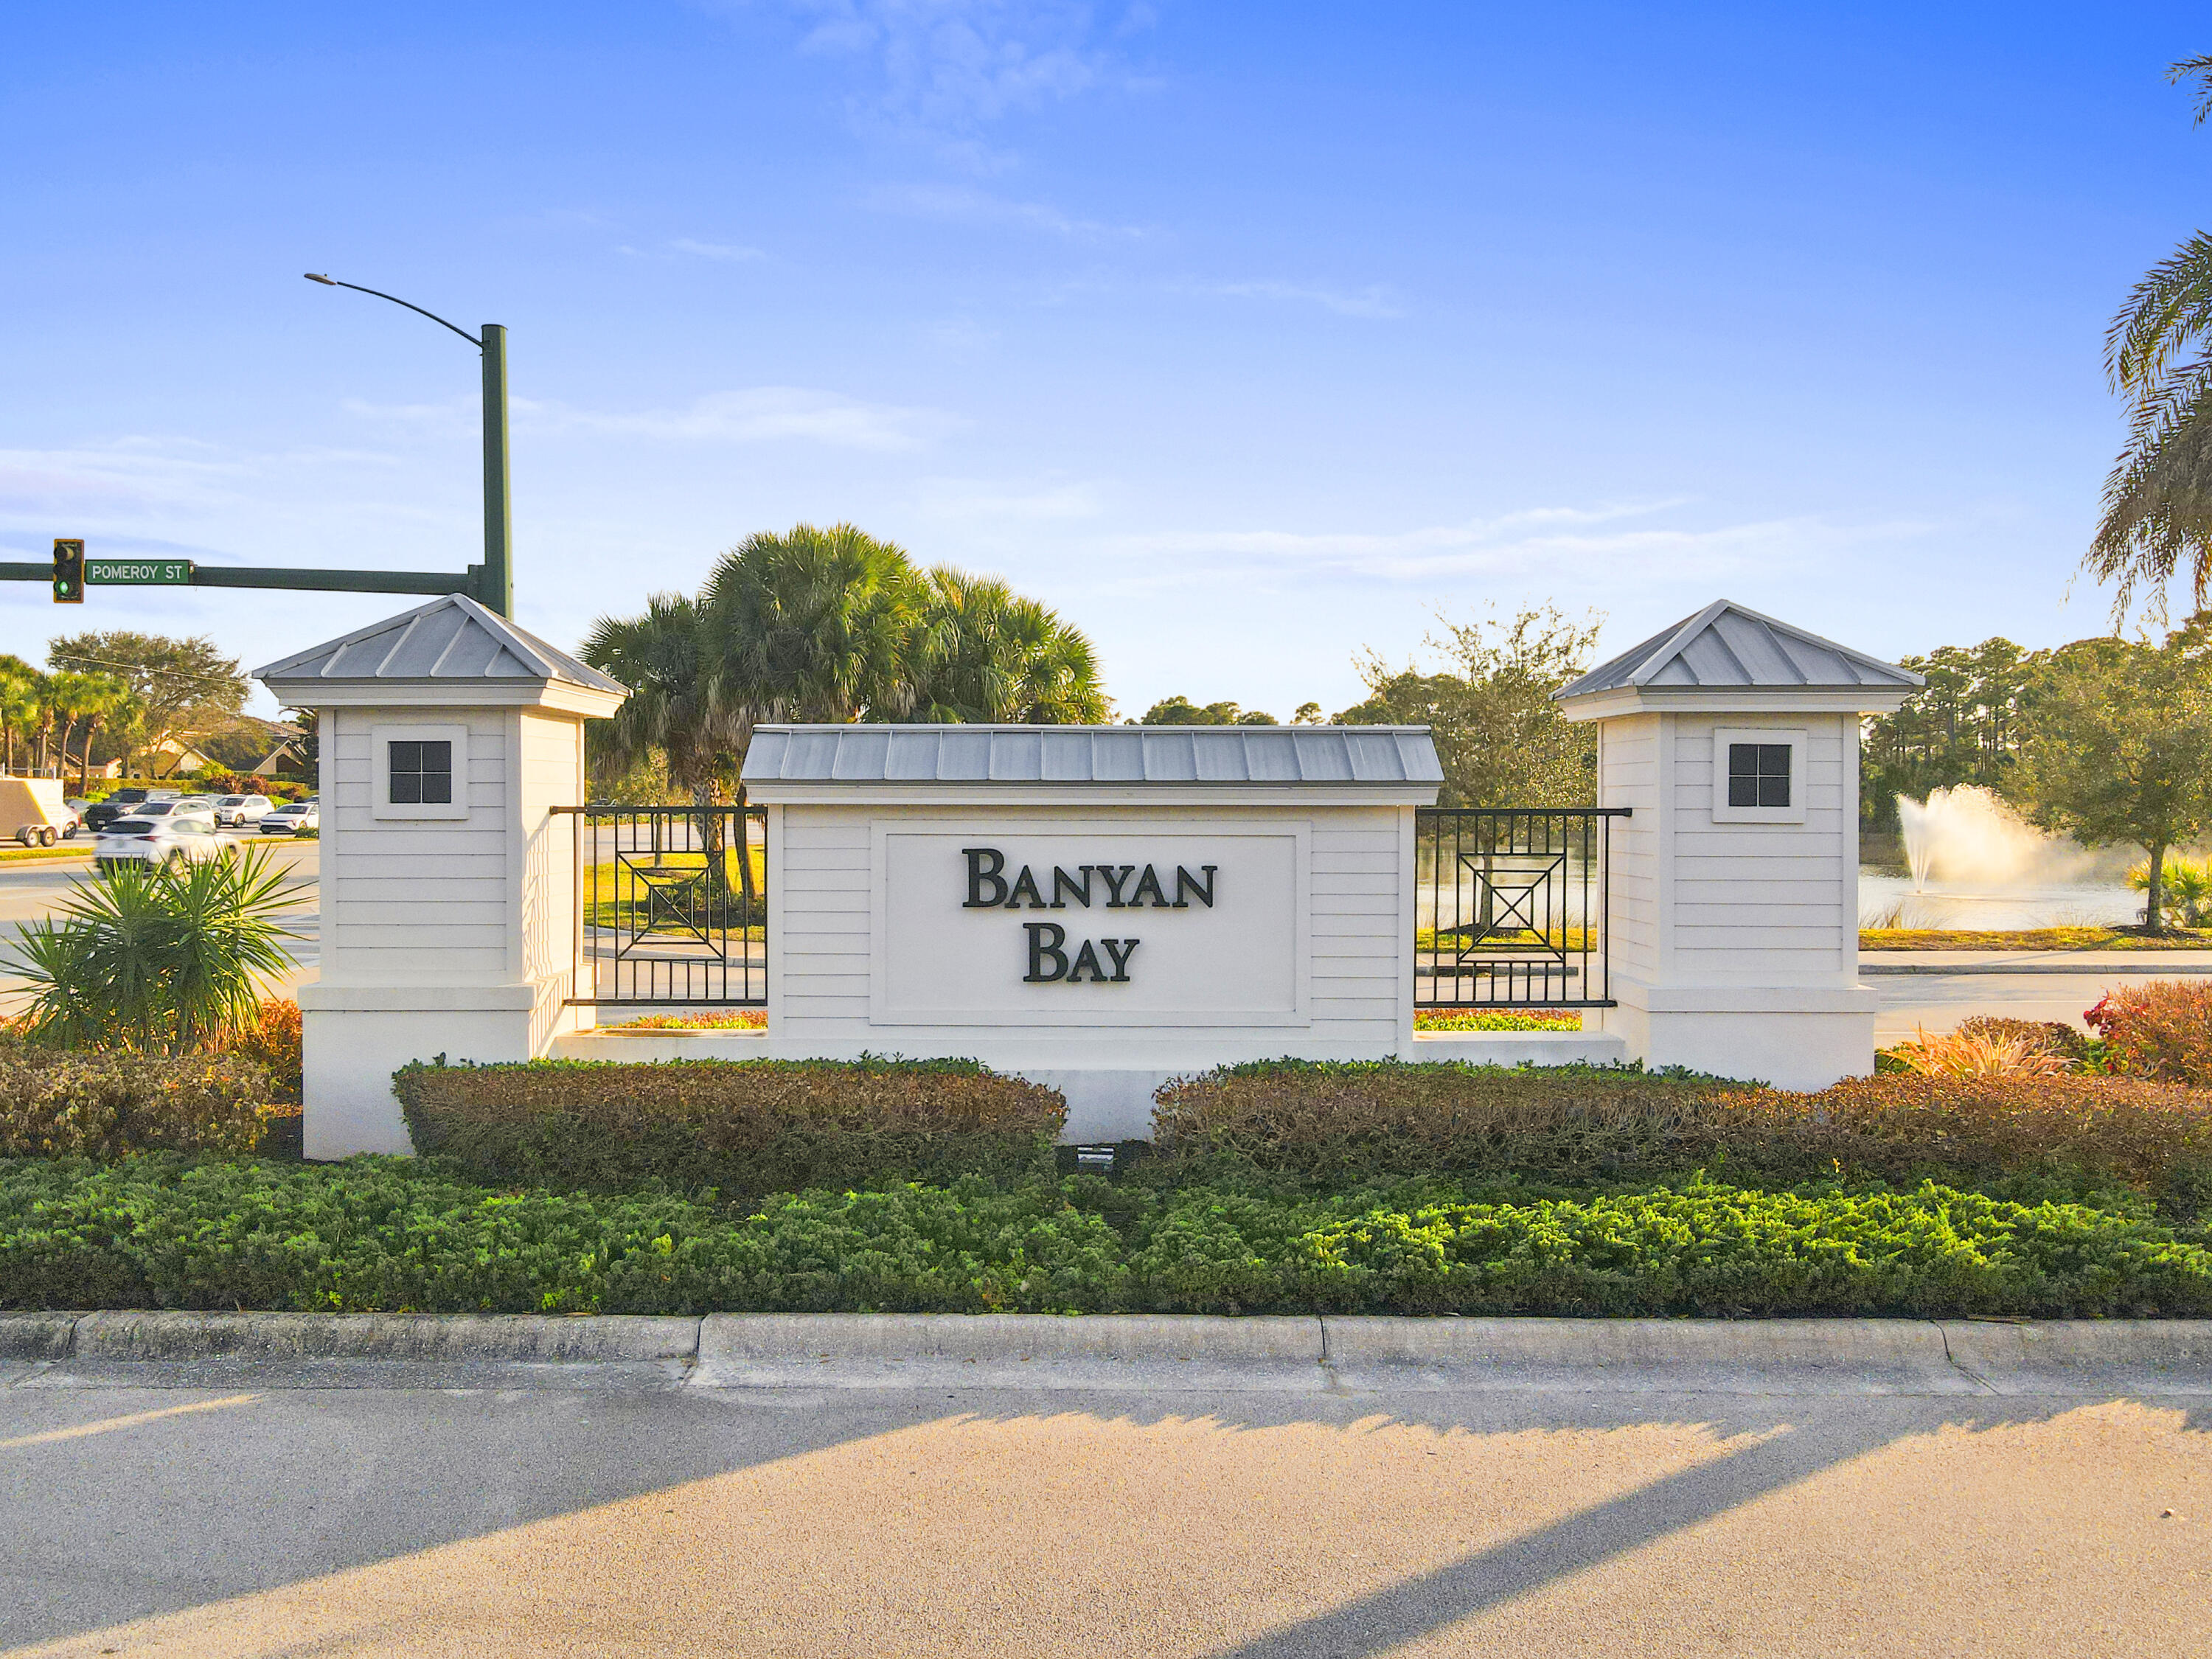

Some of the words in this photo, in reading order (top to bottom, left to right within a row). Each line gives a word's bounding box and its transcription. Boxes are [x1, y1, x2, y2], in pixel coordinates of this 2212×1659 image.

[92, 565, 158, 580] POMEROY
[165, 565, 183, 580] ST
[961, 848, 1218, 909] BANYAN
[1022, 922, 1141, 983] BAY
